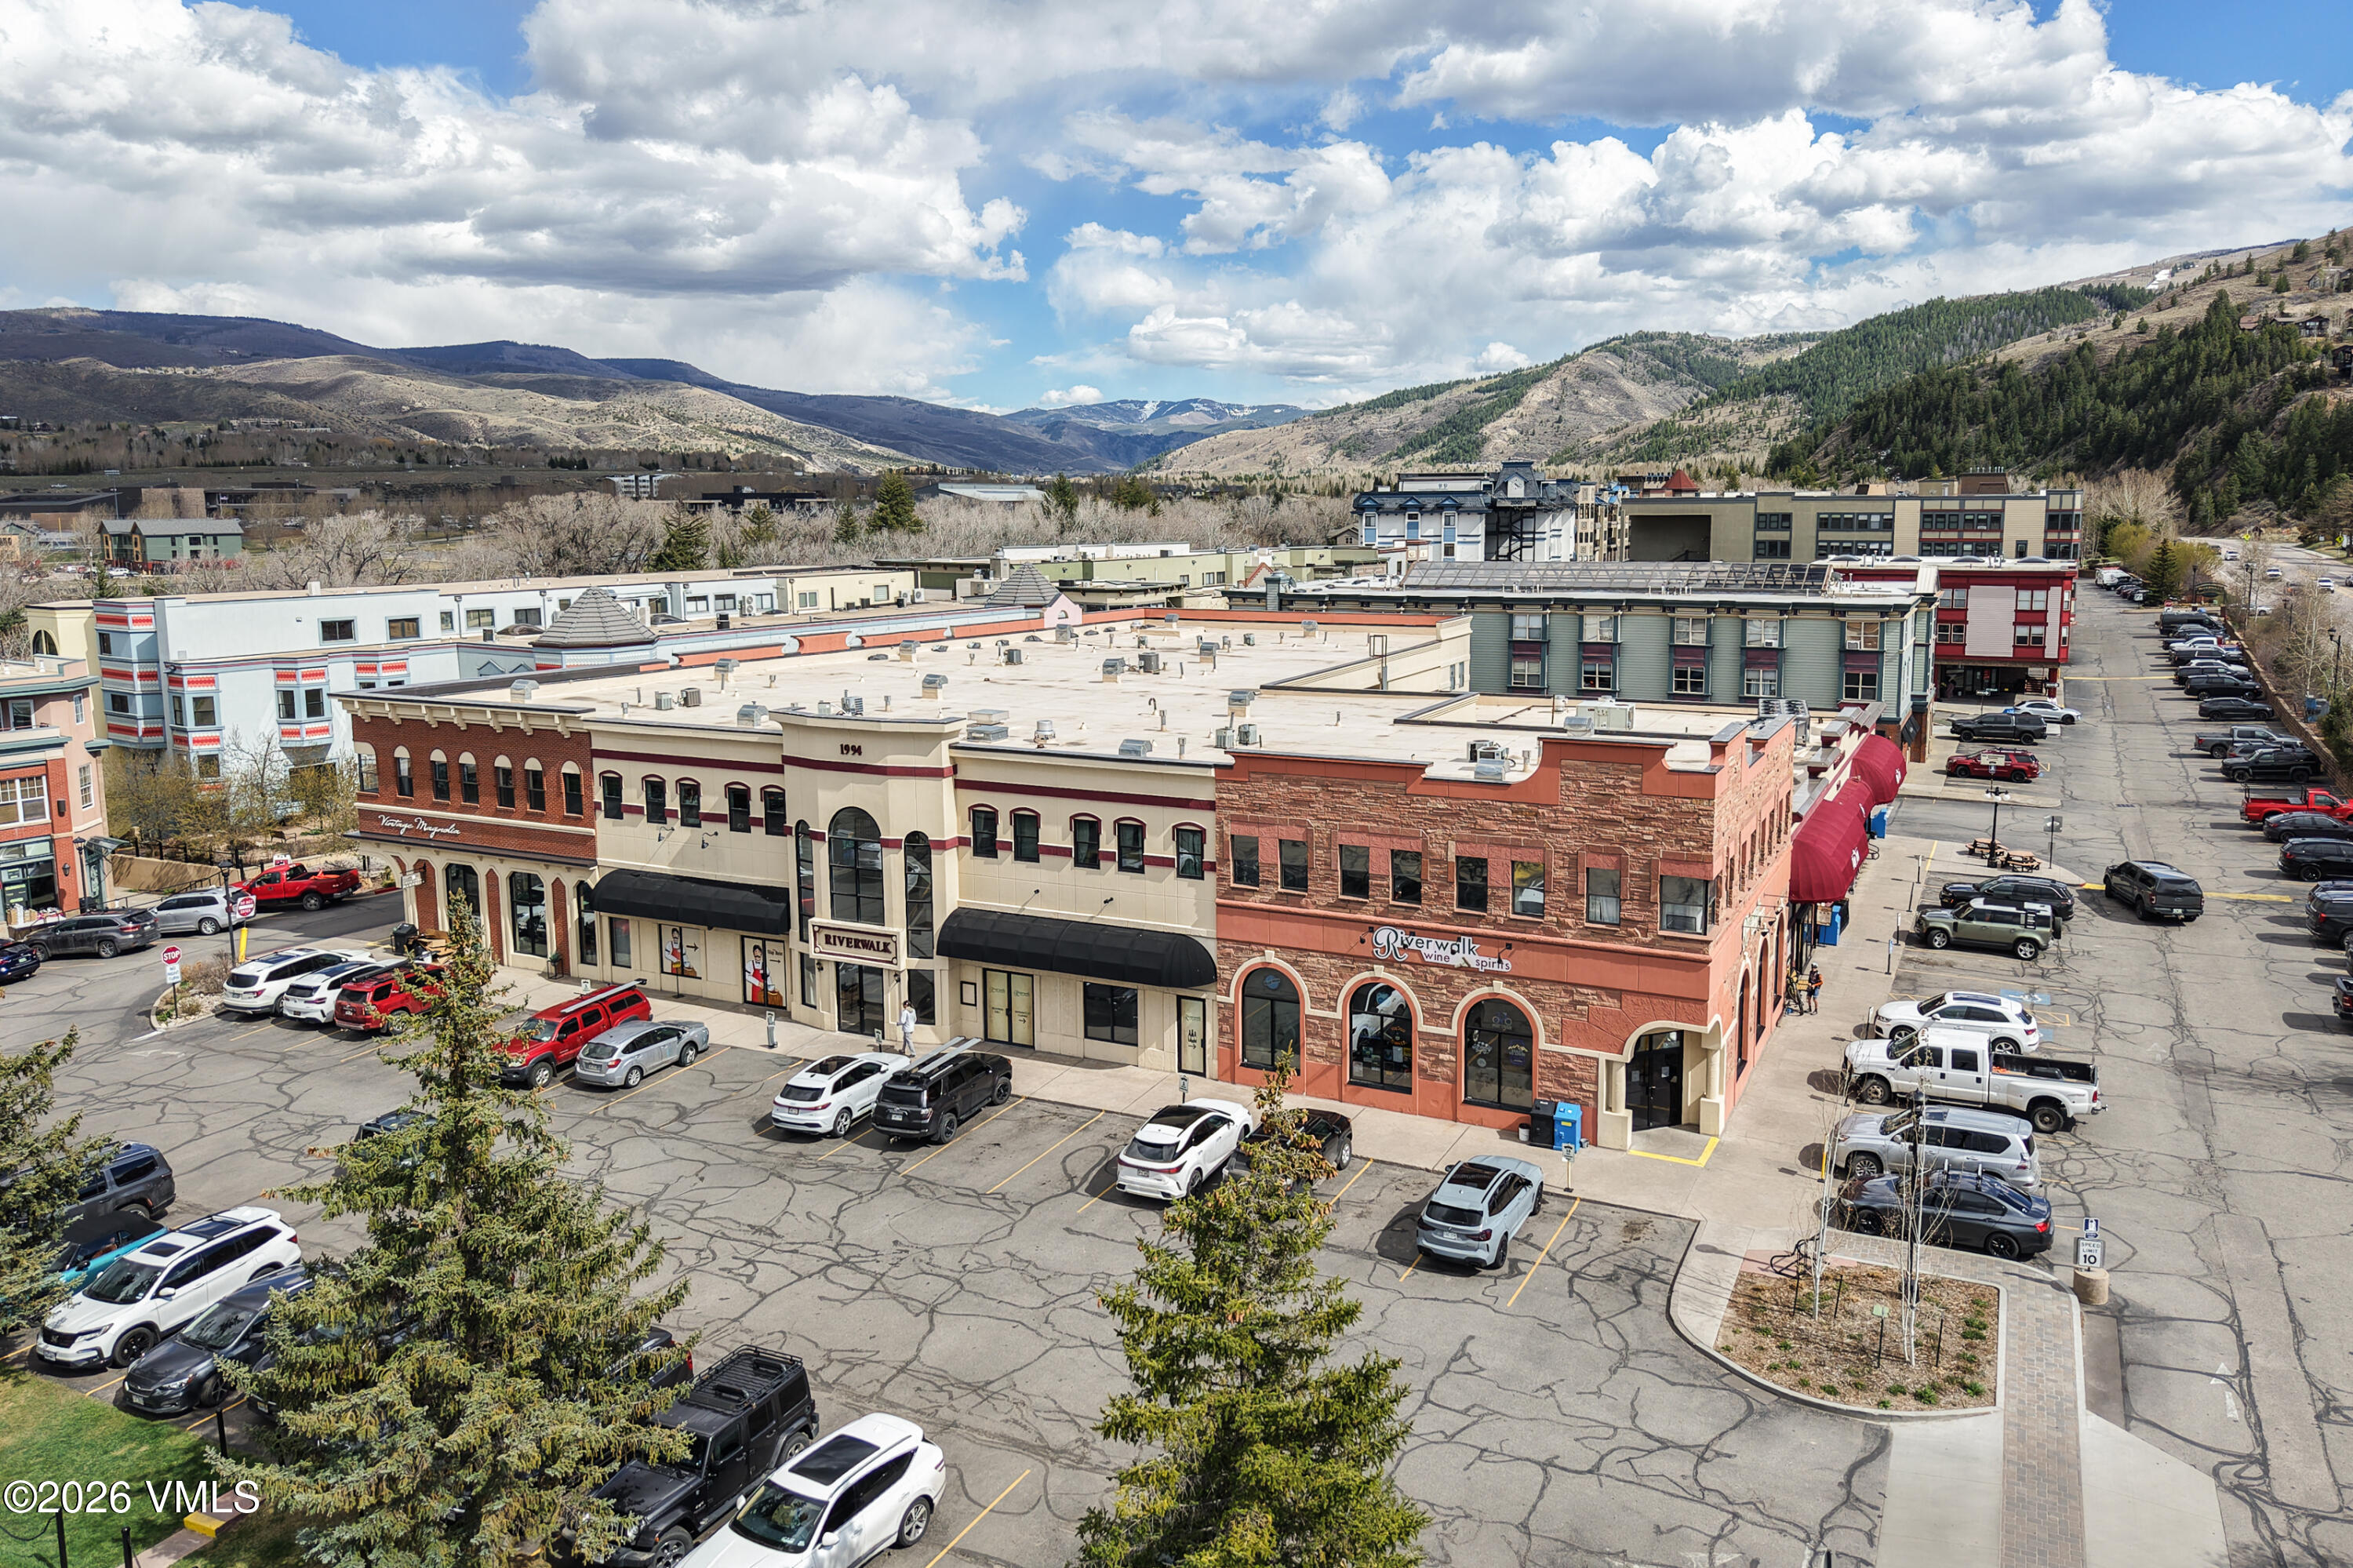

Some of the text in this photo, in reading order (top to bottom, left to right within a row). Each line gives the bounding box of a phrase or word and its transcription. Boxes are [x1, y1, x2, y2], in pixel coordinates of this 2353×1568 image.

[840, 744, 862, 755] 1994
[378, 814, 461, 839] Vintage Magnolia
[824, 933, 892, 954] RIVERWALK
[1374, 927, 1478, 960] Riverwalk
[163, 950, 180, 961] STOP
[1424, 951, 1511, 970] wine spirits
[2083, 1253, 2097, 1264] 10
